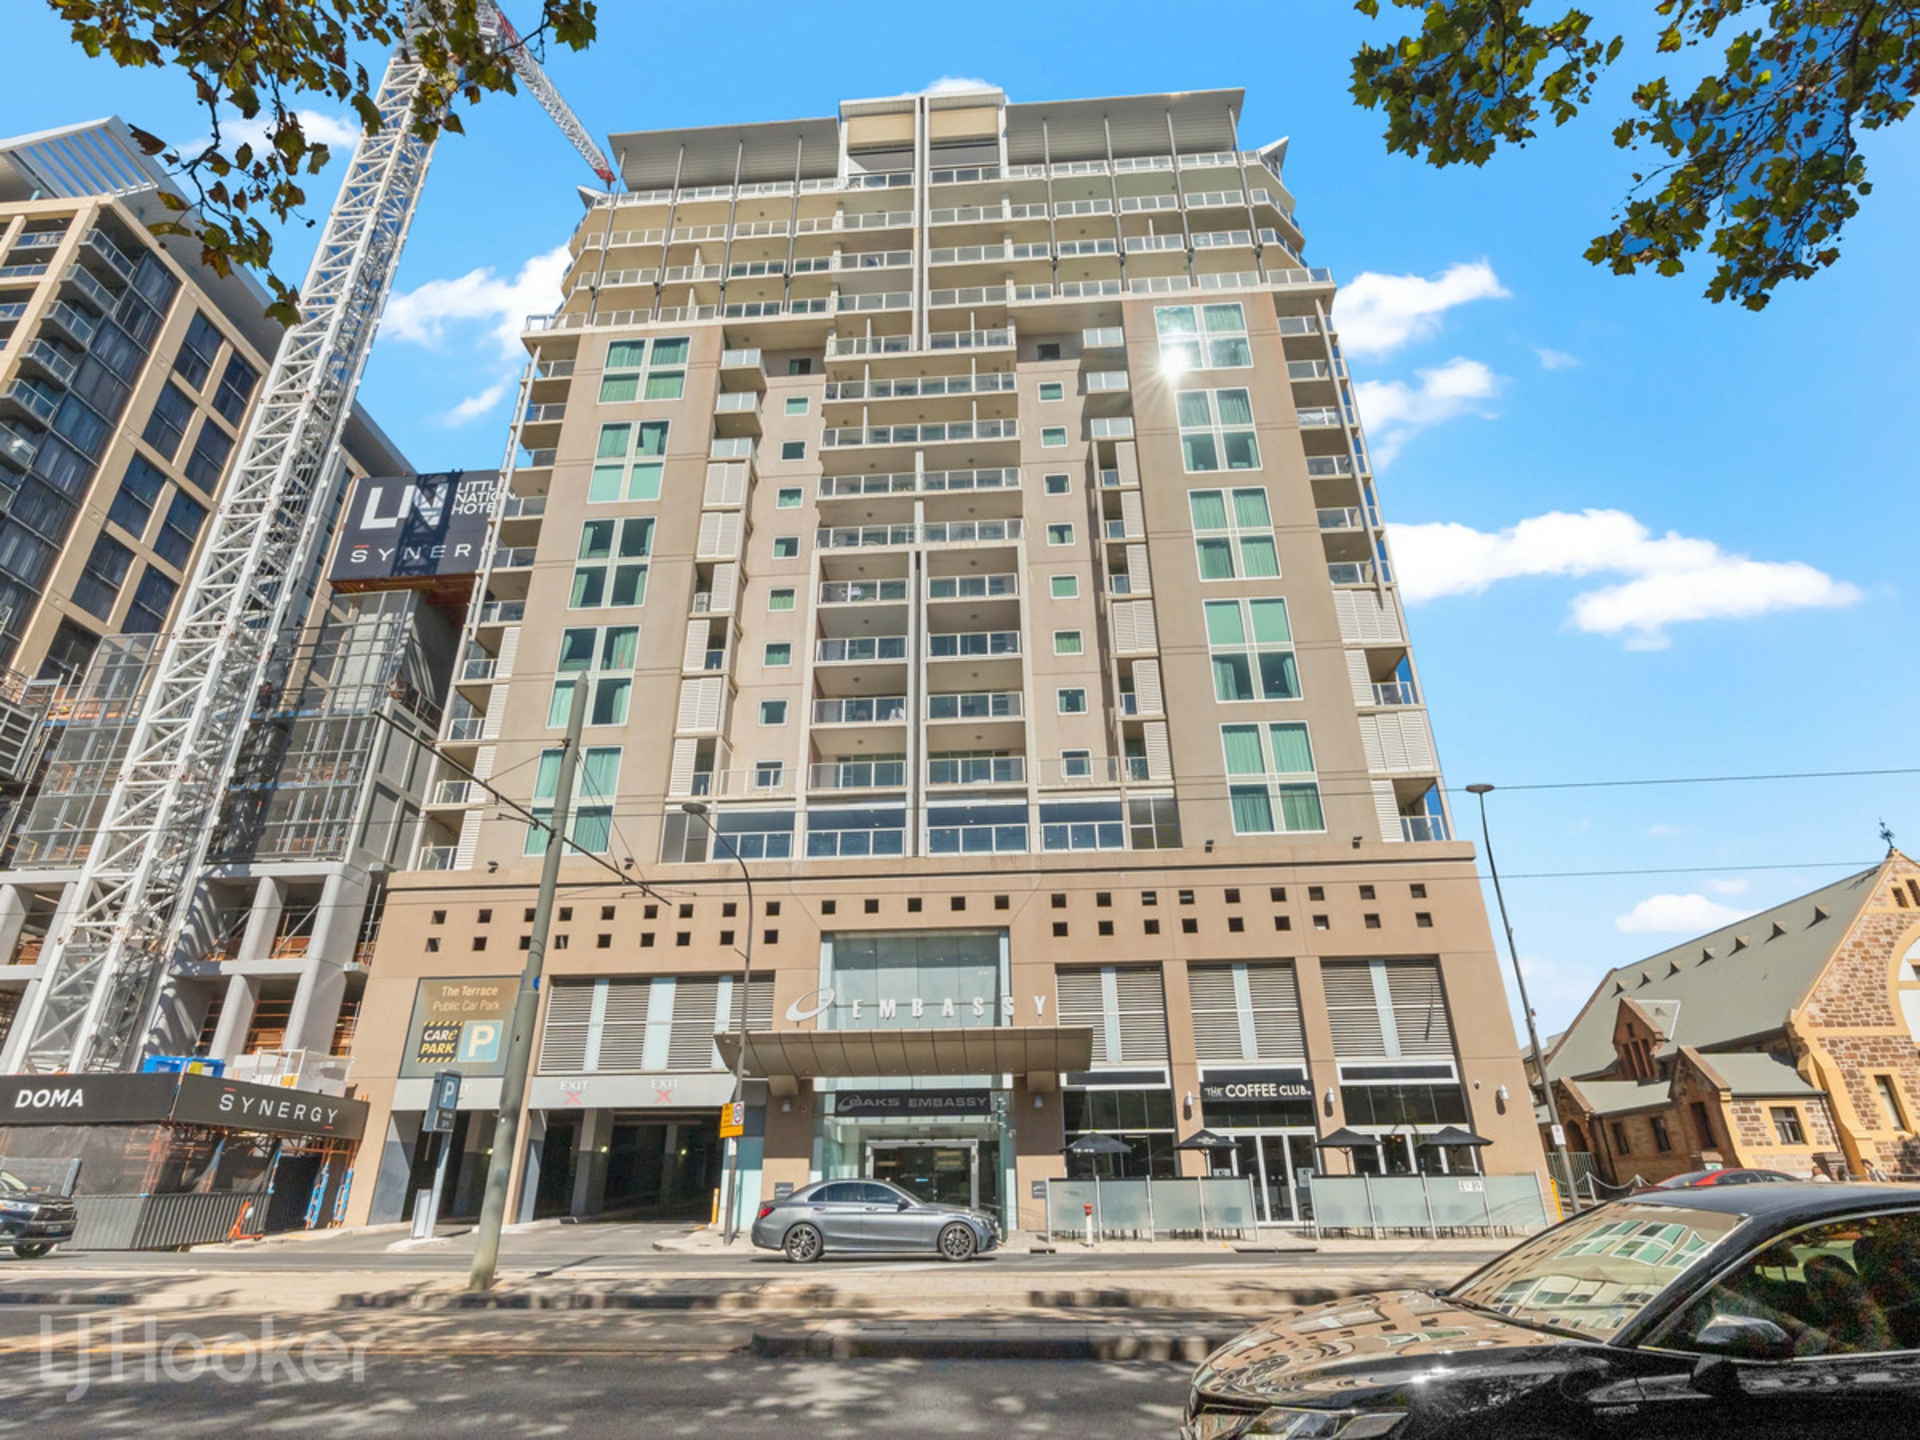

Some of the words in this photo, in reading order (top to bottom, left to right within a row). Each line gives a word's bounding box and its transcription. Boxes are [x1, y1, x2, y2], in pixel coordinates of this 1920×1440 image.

[456, 480, 503, 493] LITTL
[451, 502, 494, 515] HOTE
[351, 543, 490, 563] SYNER
[442, 986, 460, 997] The
[462, 985, 498, 996] Terrace
[433, 1001, 460, 1012] Public
[462, 1000, 478, 1011] Car
[480, 1000, 500, 1011] Park
[852, 996, 1047, 1019] EMBASSY
[467, 1025, 495, 1058] P
[420, 1043, 455, 1054] PARK
[560, 1080, 588, 1090] EXIT
[651, 1079, 680, 1089] EXIT
[1204, 1086, 1223, 1097] THE
[1225, 1083, 1278, 1098] COFFEE
[1279, 1085, 1306, 1096] CLUB
[14, 1089, 84, 1109] DOMA
[443, 1081, 455, 1104] P
[219, 1094, 339, 1124] SYNERGY
[908, 1097, 987, 1108] EMBASSY
